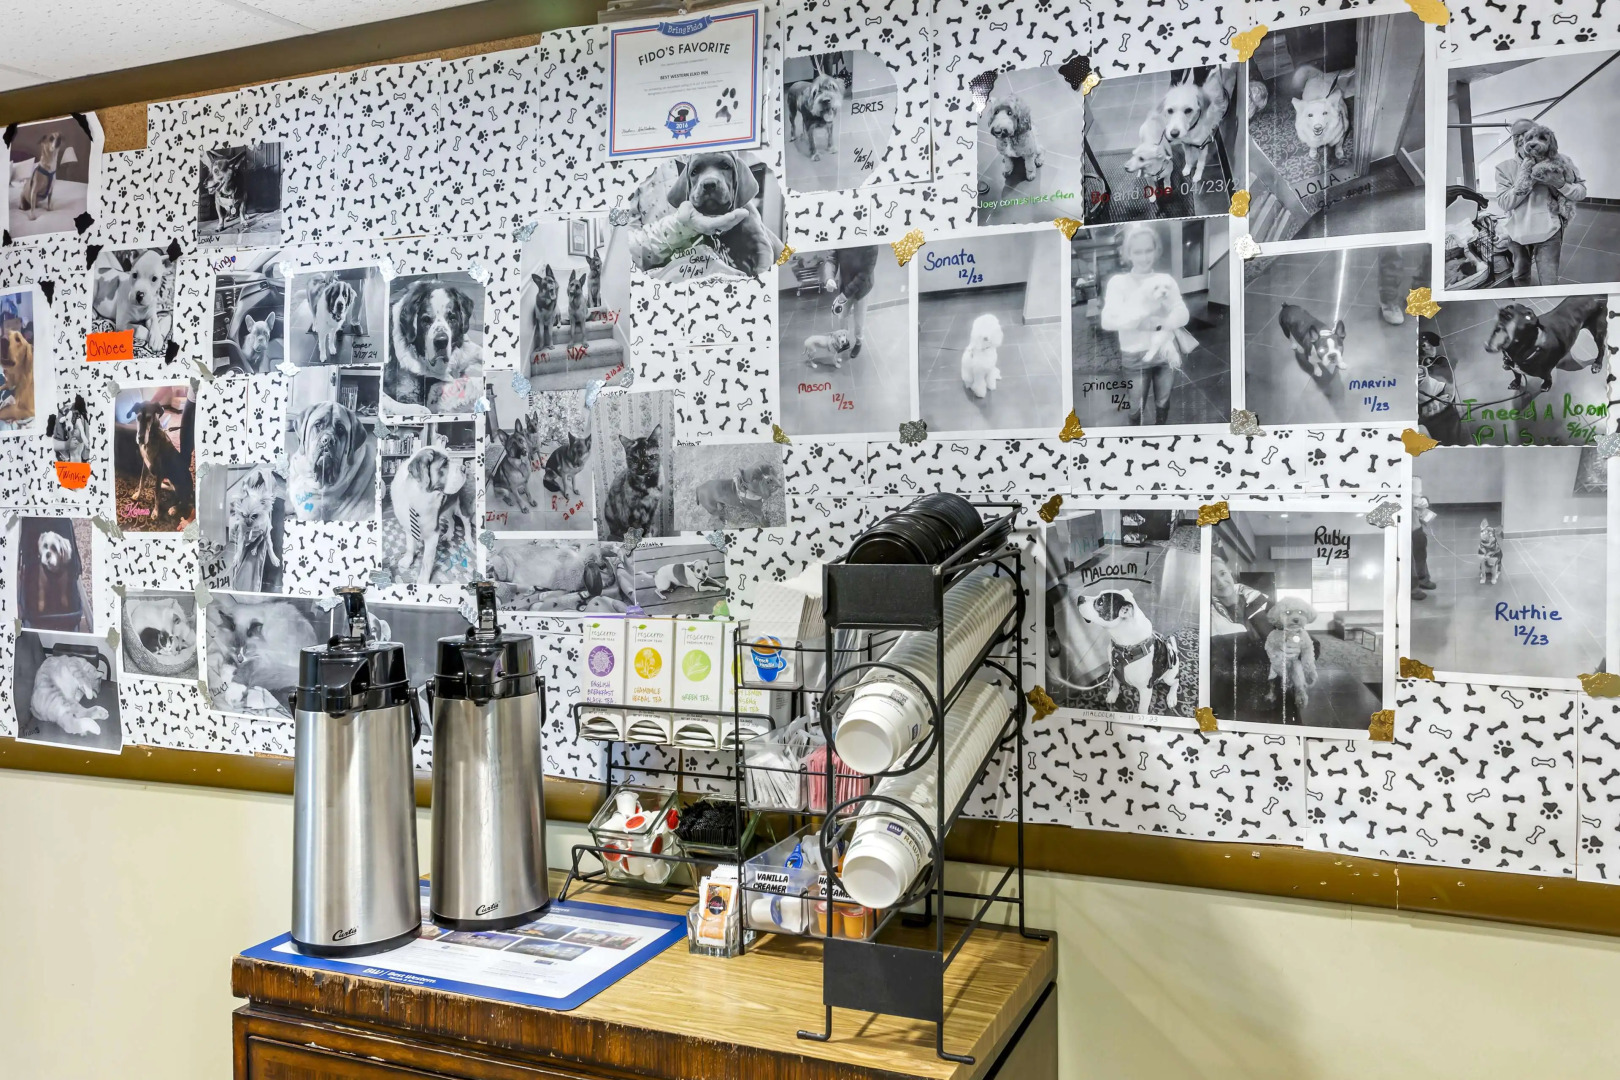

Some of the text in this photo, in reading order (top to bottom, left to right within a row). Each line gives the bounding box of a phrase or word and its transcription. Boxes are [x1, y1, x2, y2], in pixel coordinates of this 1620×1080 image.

[667, 22, 704, 35] BringFido
[638, 45, 675, 66] FIDO'S
[678, 41, 731, 55] FAVORITE
[851, 101, 884, 115] BORIS
[1113, 188, 1139, 201] and
[977, 199, 998, 210] Joey
[924, 248, 976, 271] Sonata
[958, 268, 983, 285] 12/23
[832, 393, 854, 410] 12/23
[1110, 394, 1131, 411] 12/23
[1363, 396, 1390, 413] 11/23
[1461, 398, 1478, 422] I
[1481, 400, 1537, 421] need
[1563, 392, 1607, 419] Room
[1313, 525, 1351, 551] Ruby
[1316, 547, 1350, 566] 12/23
[201, 556, 227, 580] Lexi
[209, 575, 231, 590] 2/24
[1495, 601, 1563, 622] Ruthie
[1514, 624, 1549, 646] 12/23
[757, 872, 789, 883] VANILLA
[753, 882, 787, 893] CREAMER
[475, 904, 499, 916] Curtis
[332, 929, 357, 942] Curtis
